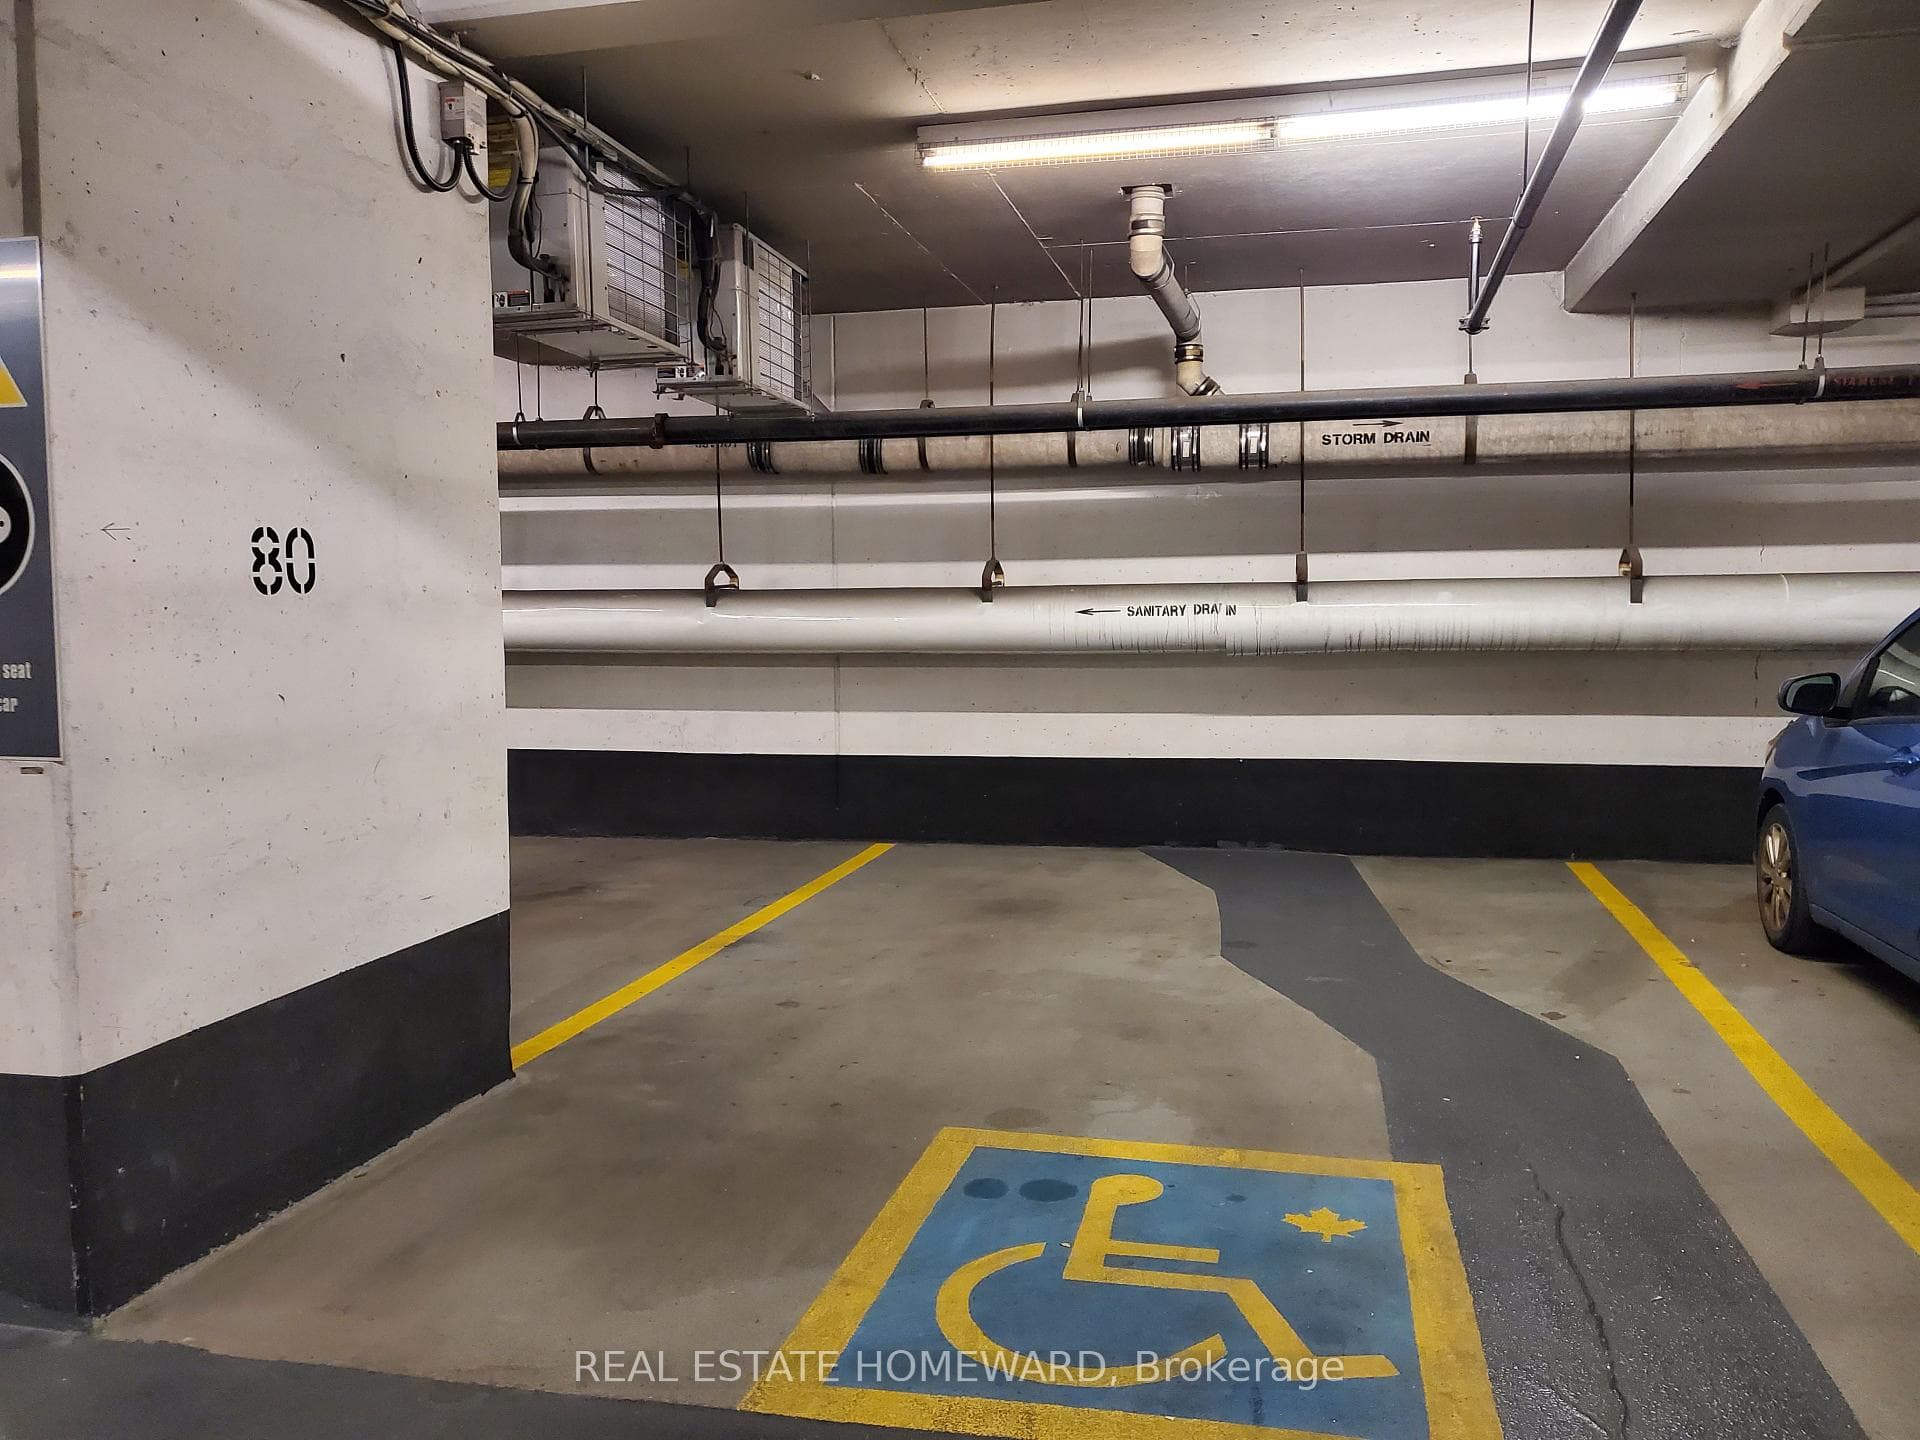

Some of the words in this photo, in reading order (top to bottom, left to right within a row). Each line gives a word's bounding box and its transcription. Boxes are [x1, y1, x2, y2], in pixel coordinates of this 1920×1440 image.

[1321, 432, 1376, 445] STORM
[1383, 430, 1430, 444] DRAIN
[251, 526, 316, 595] 80
[1127, 604, 1187, 617] SANITARY
[2, 661, 32, 679] seat
